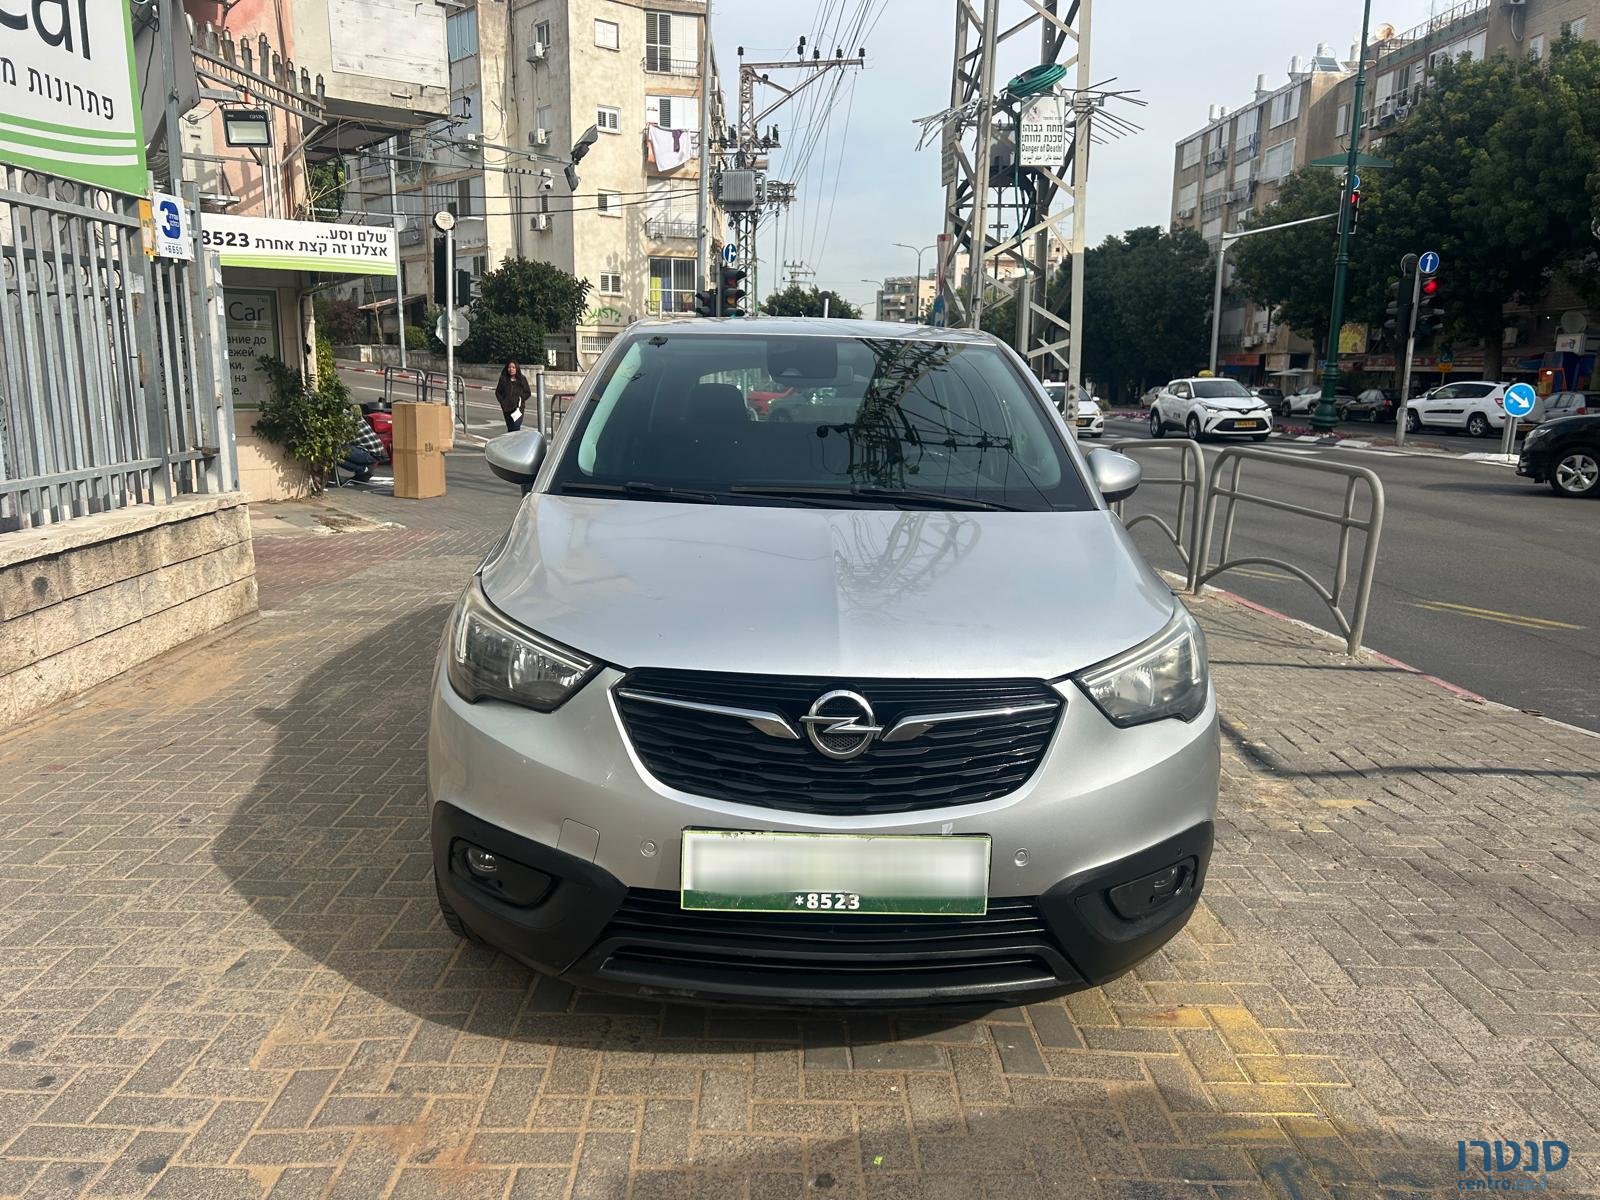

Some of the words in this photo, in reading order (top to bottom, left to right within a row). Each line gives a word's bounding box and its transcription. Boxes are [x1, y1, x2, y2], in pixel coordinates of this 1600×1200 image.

[0, 0, 91, 60] ar
[27, 66, 114, 120] פתרונות
[1022, 124, 1043, 132] גבוה!
[1046, 124, 1063, 132] מתח
[1022, 144, 1039, 153] Danger
[1040, 144, 1046, 152] of
[316, 229, 353, 241] וסע...
[358, 231, 387, 243] שלם
[255, 238, 294, 250] אחרת
[299, 240, 328, 255] קצת
[332, 243, 347, 254] זה
[351, 244, 388, 257] אצלנו
[228, 302, 264, 321] Car
[253, 336, 266, 346] до
